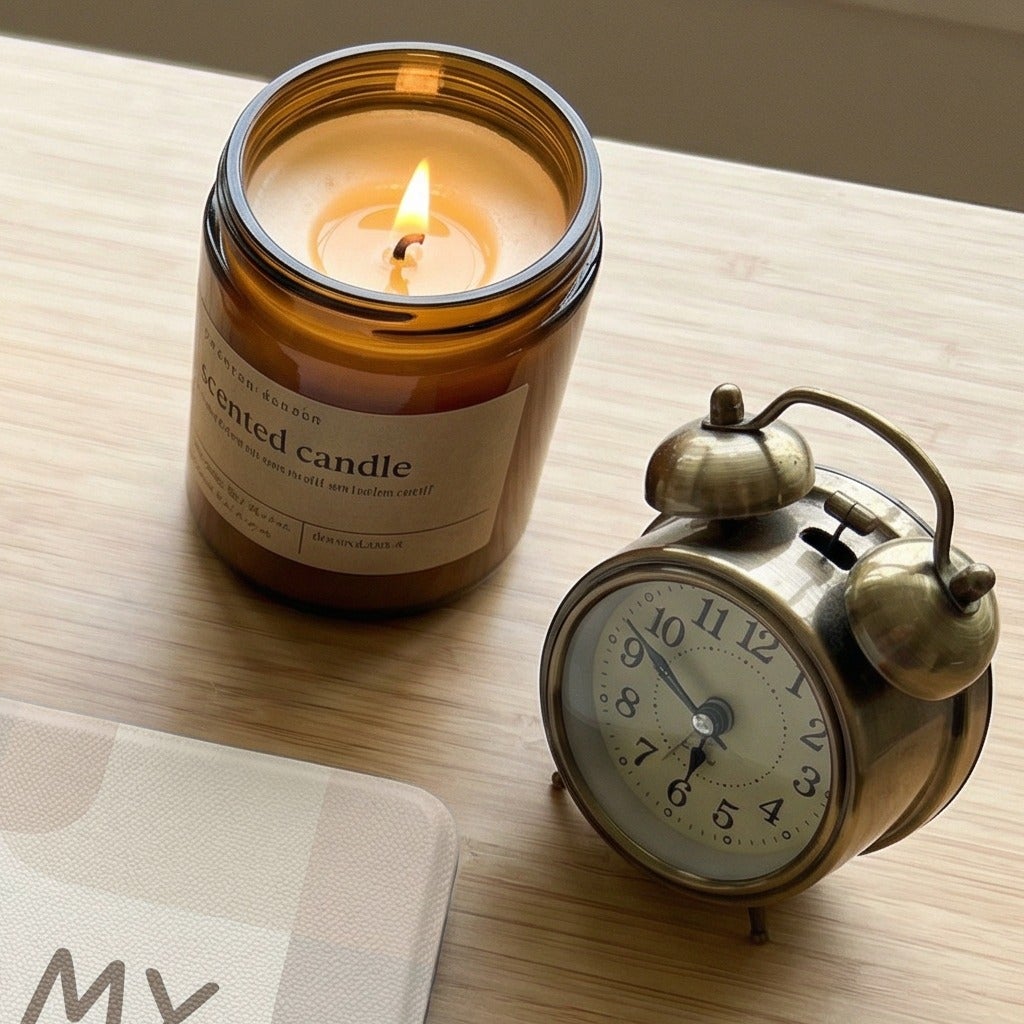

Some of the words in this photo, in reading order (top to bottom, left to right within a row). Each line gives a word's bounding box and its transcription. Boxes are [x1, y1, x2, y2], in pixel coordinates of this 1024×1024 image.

[296, 446, 412, 478] candle
[645, 608, 685, 647] 10
[691, 598, 729, 641] 11
[620, 637, 645, 668] 9
[736, 620, 780, 664] 12
[786, 665, 807, 699] 1
[615, 687, 640, 719] 8
[800, 718, 826, 751] 2
[634, 736, 659, 767] 7
[667, 778, 692, 807] 6
[793, 766, 821, 797] 3
[712, 798, 739, 830] 5
[759, 797, 785, 827] 4
